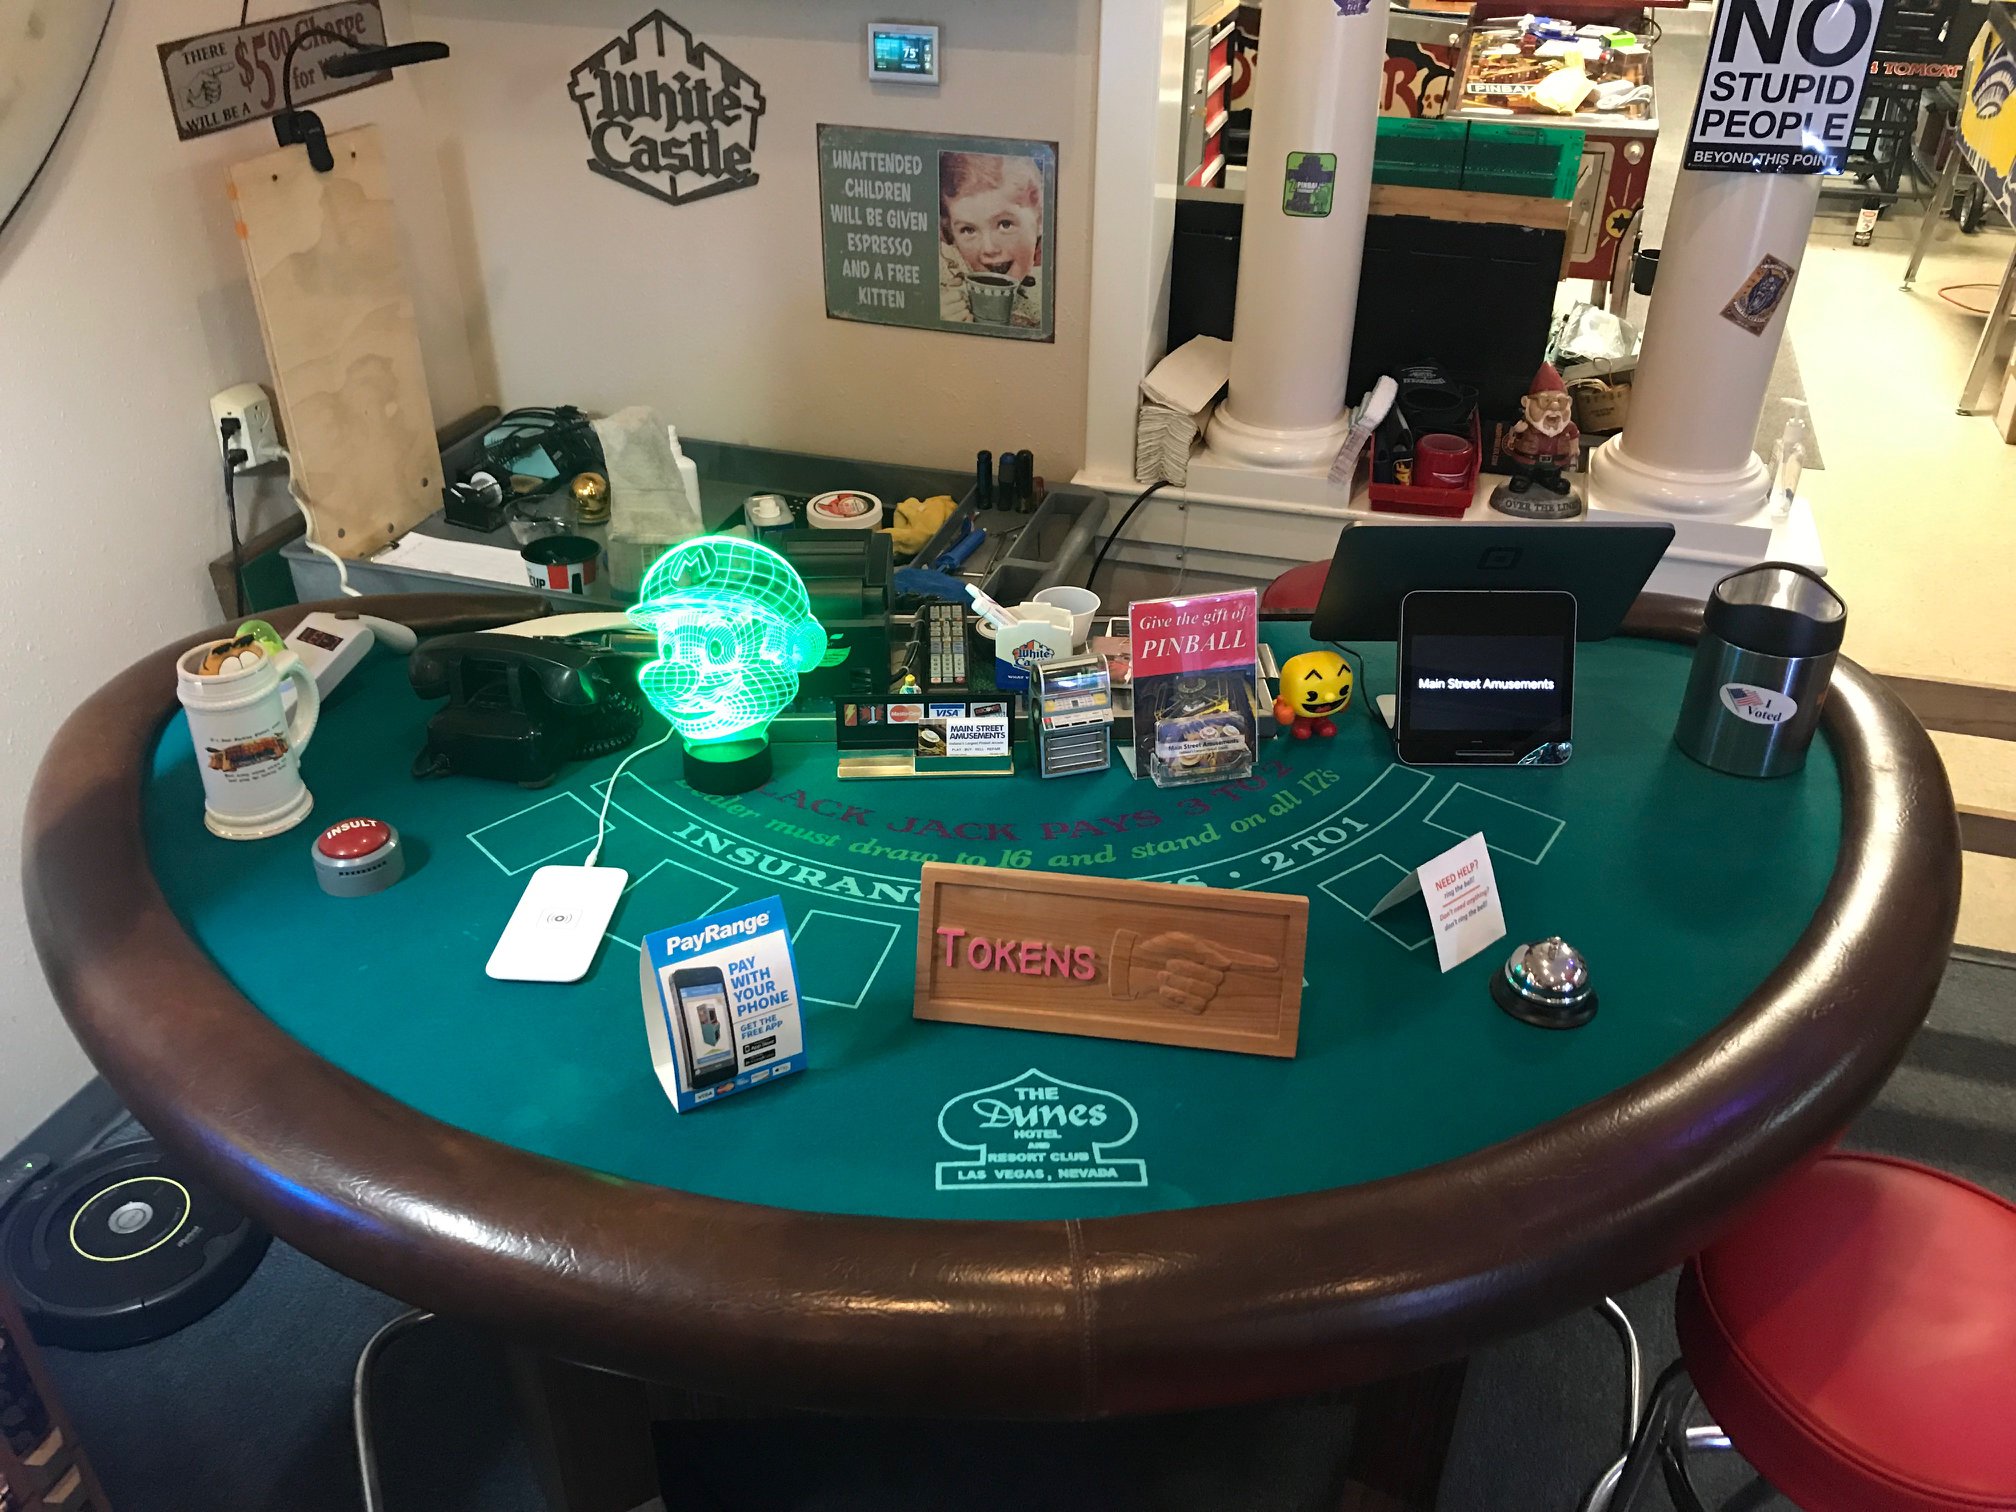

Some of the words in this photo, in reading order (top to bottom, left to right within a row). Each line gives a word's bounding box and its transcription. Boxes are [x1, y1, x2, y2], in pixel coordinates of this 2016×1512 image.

[1718, 0, 1873, 67] NO
[183, 42, 227, 65] THERE
[292, 67, 315, 90] for
[1883, 62, 1963, 78] TOMCAT
[1710, 71, 1855, 105] STUPID
[596, 69, 753, 132] White
[186, 112, 219, 132] WILL
[223, 106, 239, 120] BE
[242, 102, 251, 114] A
[1699, 110, 1850, 141] PEOPLE
[590, 120, 752, 179] Castle
[1694, 151, 1754, 164] BEYOND
[1758, 152, 1789, 165] THIS
[1792, 154, 1838, 167] POINT
[832, 150, 922, 175] UNATTENDED
[845, 178, 911, 202] CHILDREN
[830, 205, 861, 225] WILL
[866, 207, 883, 227] BE
[887, 210, 927, 232] GIVEN
[847, 234, 912, 257] ESPRESSO
[842, 260, 869, 280] AND
[874, 262, 884, 281] A
[887, 264, 920, 284] FREE
[858, 287, 905, 309] KITTEN
[1505, 500, 1531, 510] OVER
[1534, 503, 1555, 511] THE
[1140, 616, 1172, 630] Give
[1176, 612, 1199, 626] the
[1202, 608, 1228, 626] gift
[1232, 605, 1247, 622] of
[1018, 649, 1050, 659] White
[1141, 629, 1247, 659] PINBALL
[1419, 678, 1445, 689] Main
[1447, 678, 1481, 689] Street
[1483, 678, 1554, 690] Amusements
[935, 709, 959, 717] VISA
[1748, 705, 1782, 721] Voted
[1766, 699, 1771, 709] I
[950, 732, 1006, 740] AMUSEMENTS
[976, 724, 1004, 732] STREET
[1184, 742, 1201, 750] Street
[1203, 739, 1239, 748] Amusements
[326, 819, 378, 839] INSULT
[765, 819, 841, 847] must
[849, 838, 939, 862] draw
[955, 850, 987, 867] to
[1001, 848, 1032, 868] 16
[1048, 844, 1116, 867] and
[1131, 823, 1220, 860] stand
[1230, 810, 1266, 833] on
[1269, 789, 1302, 817] all
[887, 817, 1021, 841] JACK
[1040, 808, 1163, 840] PAYS
[1261, 851, 1295, 872] 2
[1435, 873, 1456, 890] NEED
[1456, 859, 1479, 879] HELP?
[1444, 889, 1455, 899] ring
[1455, 884, 1463, 893] the
[1439, 909, 1454, 921] Don't
[1454, 903, 1467, 913] need
[1466, 886, 1490, 906] anything?
[1444, 917, 1457, 931] don't
[1458, 913, 1468, 923] ring
[1468, 908, 1477, 917] the
[666, 912, 769, 956] PayRange
[936, 926, 1096, 981] TOKENS
[728, 956, 755, 975] PAY
[731, 967, 771, 989] WITH
[734, 980, 776, 1002] YOUR
[737, 990, 789, 1017] PHONE
[740, 1020, 758, 1031] GET
[760, 1014, 777, 1027] THE
[741, 1027, 764, 1040] FREE
[765, 1020, 783, 1033] APP
[1014, 1087, 1060, 1100] THE
[973, 1098, 1107, 1128] Dunes
[1014, 1129, 1062, 1140] HOTEL
[988, 1152, 1047, 1163] RESORT
[1050, 1151, 1090, 1162] CLUB
[1027, 1142, 1050, 1150] AND
[958, 1170, 987, 1180] LAS
[1058, 1168, 1118, 1179] NEVADA
